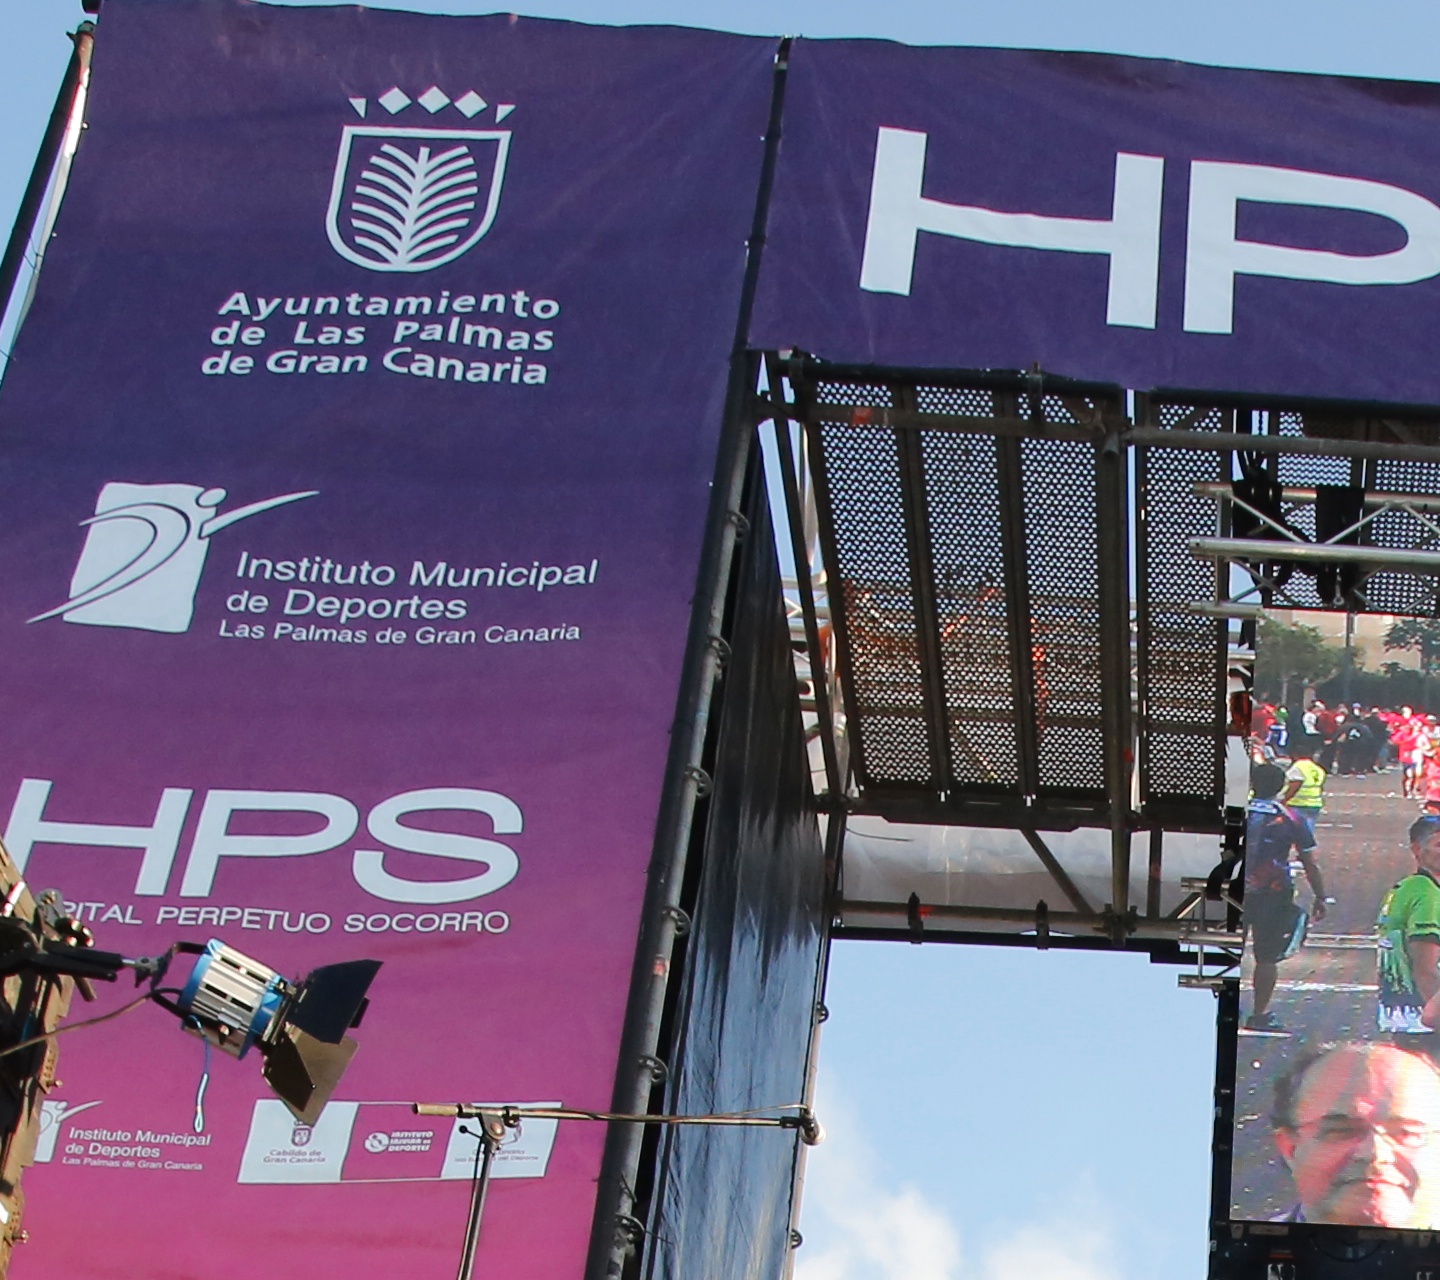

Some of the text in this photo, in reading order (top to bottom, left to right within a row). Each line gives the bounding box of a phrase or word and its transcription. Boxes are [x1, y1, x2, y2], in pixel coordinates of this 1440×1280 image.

[218, 290, 560, 321] Ayuntamiento
[210, 317, 555, 352] de Las Palmas
[202, 347, 549, 386] de Gran Canaria
[235, 550, 598, 594] Instituto Municipal
[226, 588, 468, 622] de Deportes
[219, 619, 580, 645] Las Palmas de Gran Canaria
[3, 777, 525, 904] HPS
[156, 906, 331, 933] PERPETUO
[343, 911, 509, 934] SOCORRO
[65, 1143, 160, 1159] de Deportes
[68, 1127, 211, 1146] Instituto Municipal
